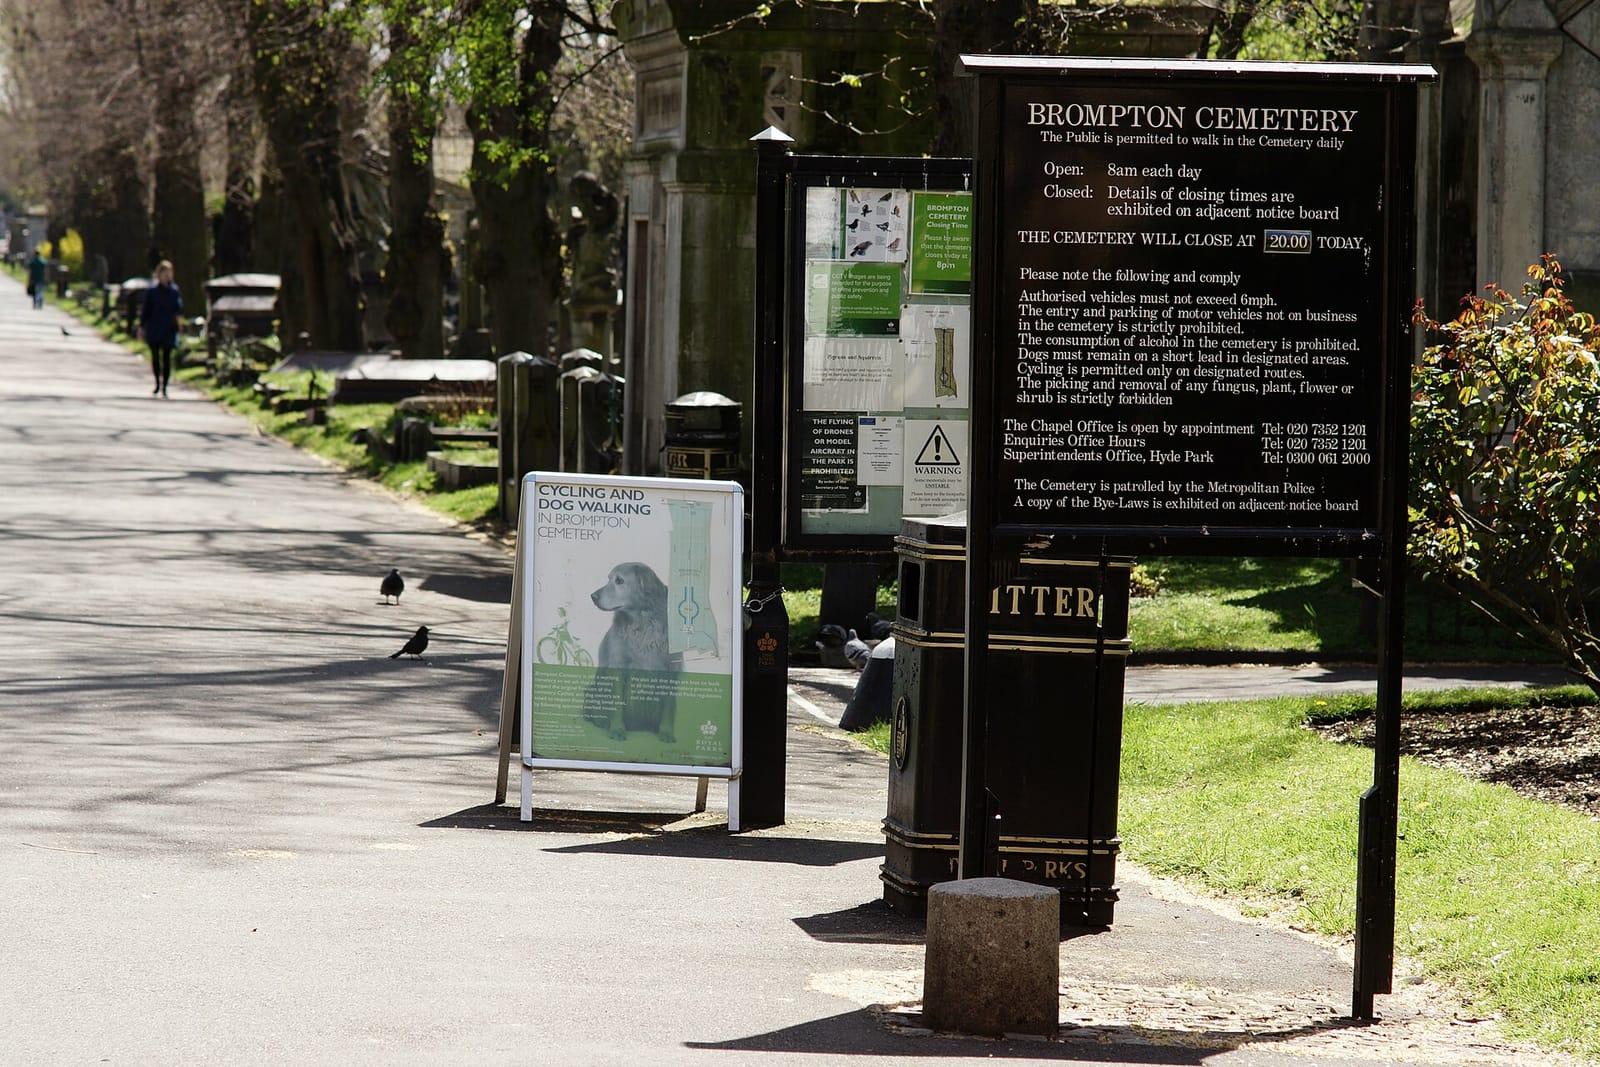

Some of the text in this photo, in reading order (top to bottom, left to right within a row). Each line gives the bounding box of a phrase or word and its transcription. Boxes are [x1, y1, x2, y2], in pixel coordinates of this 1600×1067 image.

[1028, 103, 1357, 131] BROMPTON CEMETERY
[1040, 132, 1344, 150] The Public is permitted to walk in the Cemetery daily
[1044, 162, 1201, 180] Open: 8am each day
[1044, 184, 1294, 204] Closed: Details of closing times are
[1107, 203, 1338, 219] exhibited on adjacent notice board
[1018, 231, 1362, 248] THE CEMETERY WILL CLOSE AT 20.00 TODAY
[937, 261, 955, 270] 8pm
[1020, 268, 1240, 285] Please note the following and comply
[1019, 290, 1276, 308] Authorised vehicles must not exceed 6mph.
[1017, 362, 1304, 381] Cycling is permitted only on designated routes.
[1004, 419, 1365, 436] The Chapel Office is open by appointment Tel: 020 7352 1201
[1003, 448, 1370, 464] Superintendents Office, Hyde Park Tel: 0300 061 2000
[539, 485, 644, 501] CYCLING AND
[1014, 478, 1314, 495] The Cemetery is patrolled by the Metropolitan Police
[539, 499, 651, 515] DOG WALKING
[538, 513, 630, 528] IN BROMPTON
[538, 527, 602, 540] CEMETERY
[990, 585, 1096, 617] ITTER
